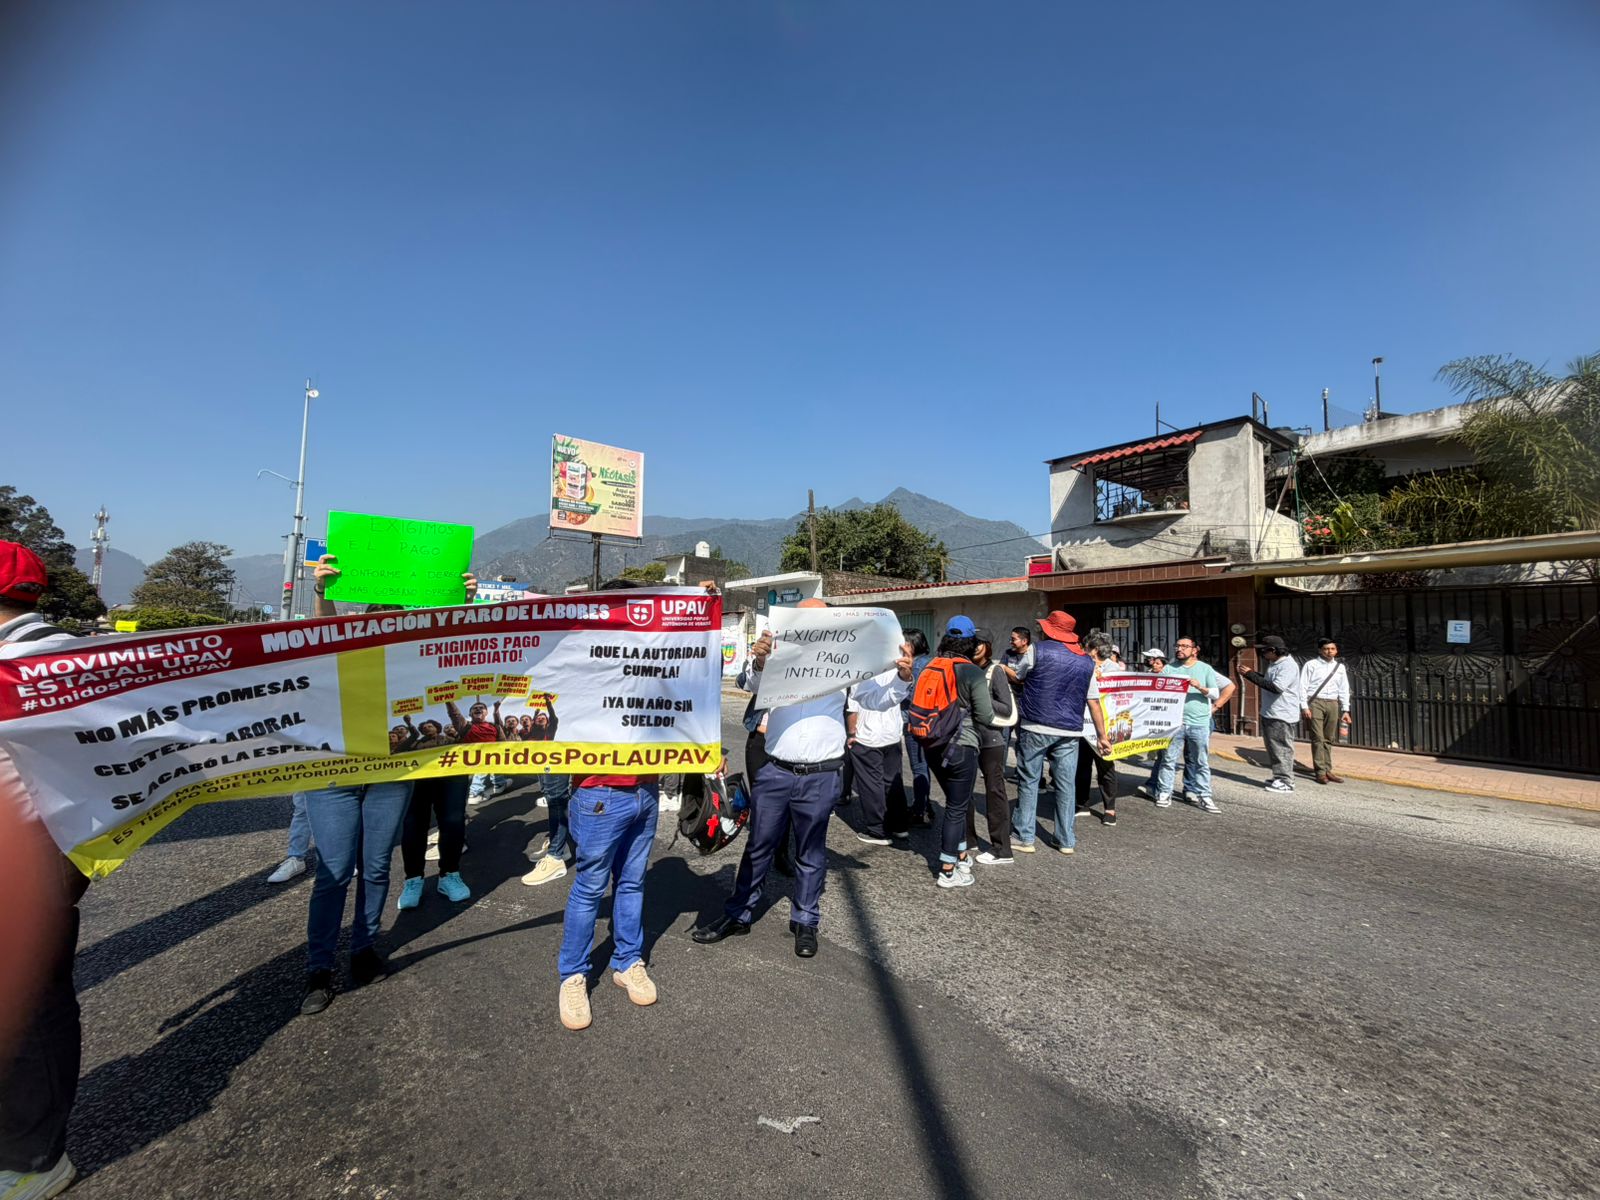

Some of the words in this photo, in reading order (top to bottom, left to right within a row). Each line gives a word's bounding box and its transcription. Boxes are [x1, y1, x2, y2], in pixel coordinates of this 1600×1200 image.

[370, 518, 455, 535] EXIGIMOS
[349, 538, 376, 550] EL
[400, 541, 440, 555] PAGO
[341, 565, 401, 578] CONFORME
[661, 599, 707, 615] UPAV
[261, 612, 432, 654] MOVILIZACIÓN
[434, 611, 450, 627] Y
[452, 605, 504, 625] PARO
[506, 604, 530, 621] DE
[531, 603, 610, 620] LABORES
[420, 636, 498, 656] ¡EXIGIMOS
[503, 635, 540, 649] PAGO
[590, 646, 620, 659] ¡QUE
[622, 647, 639, 660] LA
[642, 646, 707, 660] AUTORIDAD
[18, 634, 223, 681] MOVIMIENTO
[438, 649, 523, 668] INMEDIATO!
[816, 651, 850, 665] PAGO
[17, 663, 152, 699] ESTATAL
[162, 648, 233, 670] UPAV
[461, 676, 494, 685] Exigimos
[501, 674, 528, 682] Respeto
[622, 665, 680, 679] CUMPLA!
[21, 661, 232, 711] #UnidosPorLaUPAV
[427, 683, 459, 694] #Somos
[467, 683, 489, 691] Pagos
[433, 692, 455, 702] UPAV
[603, 696, 623, 709] ¡YA
[627, 697, 646, 710] UN
[646, 696, 672, 712] AÑO
[673, 699, 693, 712] SIN
[74, 727, 117, 744] NO
[118, 705, 179, 738] MÁS
[182, 675, 311, 716] PROMESAS
[621, 715, 675, 728] SUELDO!
[438, 748, 711, 767] #UnidosPorLAUPAV
[111, 791, 146, 810] SE
[147, 752, 219, 797] ACABÓ
[221, 751, 250, 766] LA
[175, 768, 280, 798] MAGISTERIO
[285, 763, 307, 773] HA
[112, 828, 134, 845] ES
[207, 781, 241, 794] QUE
[247, 777, 266, 786] LA
[272, 766, 359, 783] AUTORIDAD
[364, 760, 419, 773] CUMPLA
